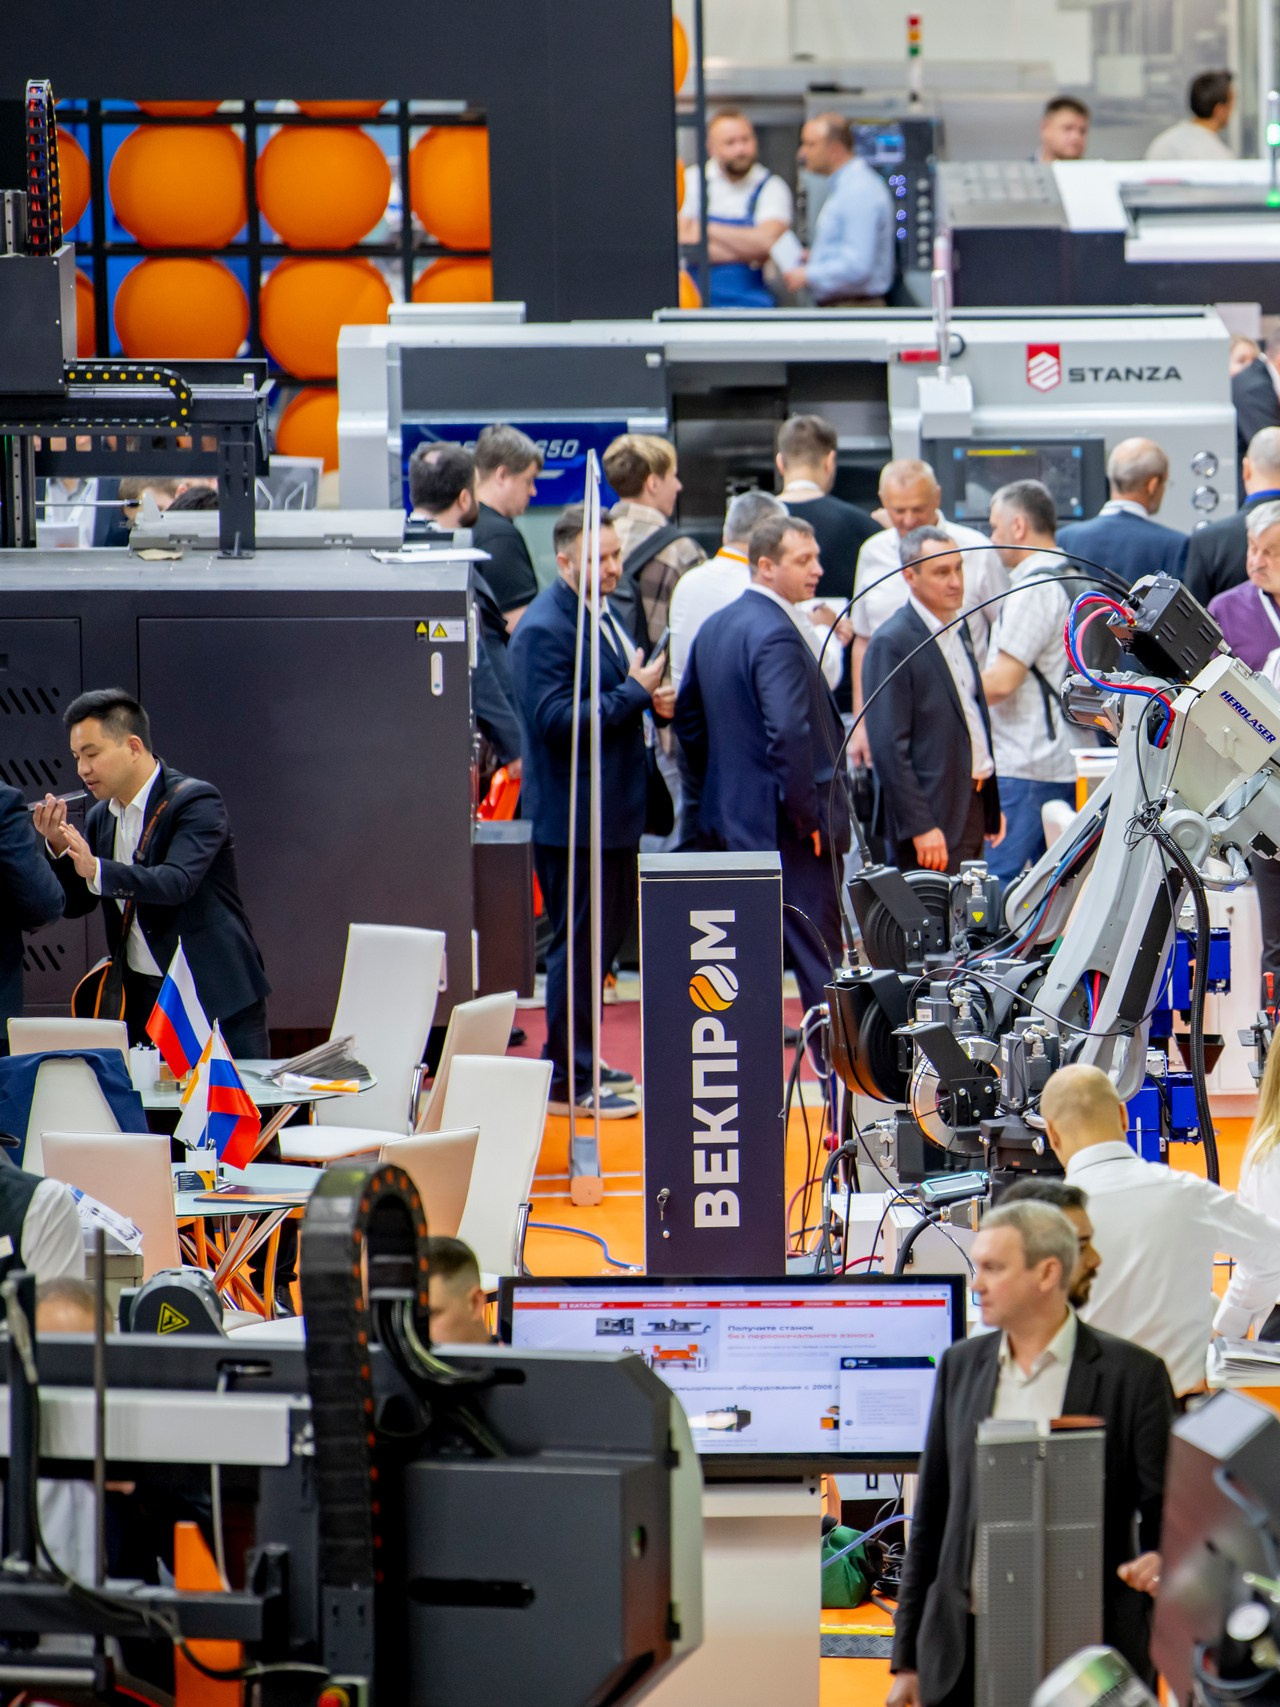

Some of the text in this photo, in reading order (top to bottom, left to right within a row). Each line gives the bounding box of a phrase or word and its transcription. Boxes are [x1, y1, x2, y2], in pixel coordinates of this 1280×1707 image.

[1068, 366, 1182, 383] STANZA
[1219, 690, 1277, 743] HEROLASER
[688, 909, 741, 1229] ВЕКПРОМ
[727, 1325, 777, 1333] Получите
[736, 1383, 802, 1392] оборудование
